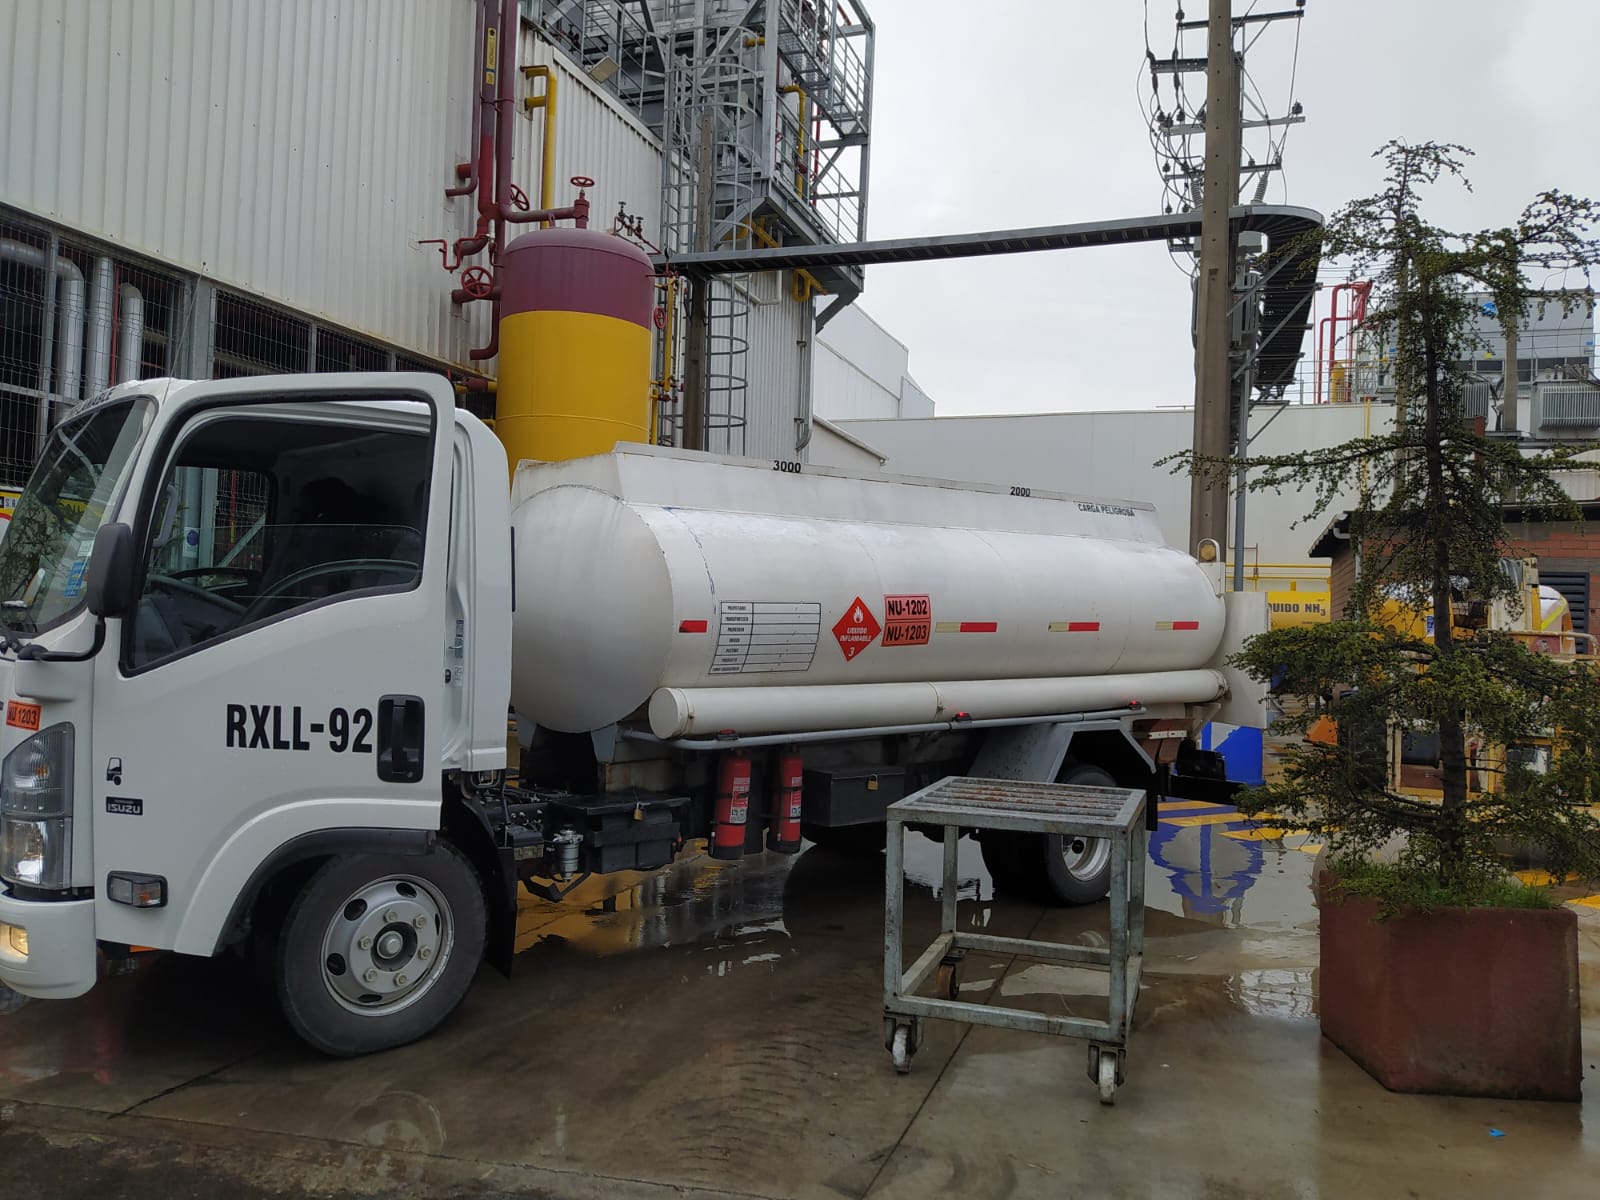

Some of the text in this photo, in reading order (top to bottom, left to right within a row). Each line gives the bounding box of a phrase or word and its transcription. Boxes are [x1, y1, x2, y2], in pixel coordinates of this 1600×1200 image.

[773, 460, 801, 473] 3000
[1010, 486, 1031, 497] 2000
[1078, 503, 1135, 517] CARGA PELIGROSA
[887, 599, 928, 616] NU-1202
[886, 625, 927, 641] NU-1203
[848, 646, 856, 657] 3
[18, 708, 37, 726] 1203
[226, 703, 373, 753] RXLL-92
[107, 803, 141, 814] ISUZU
